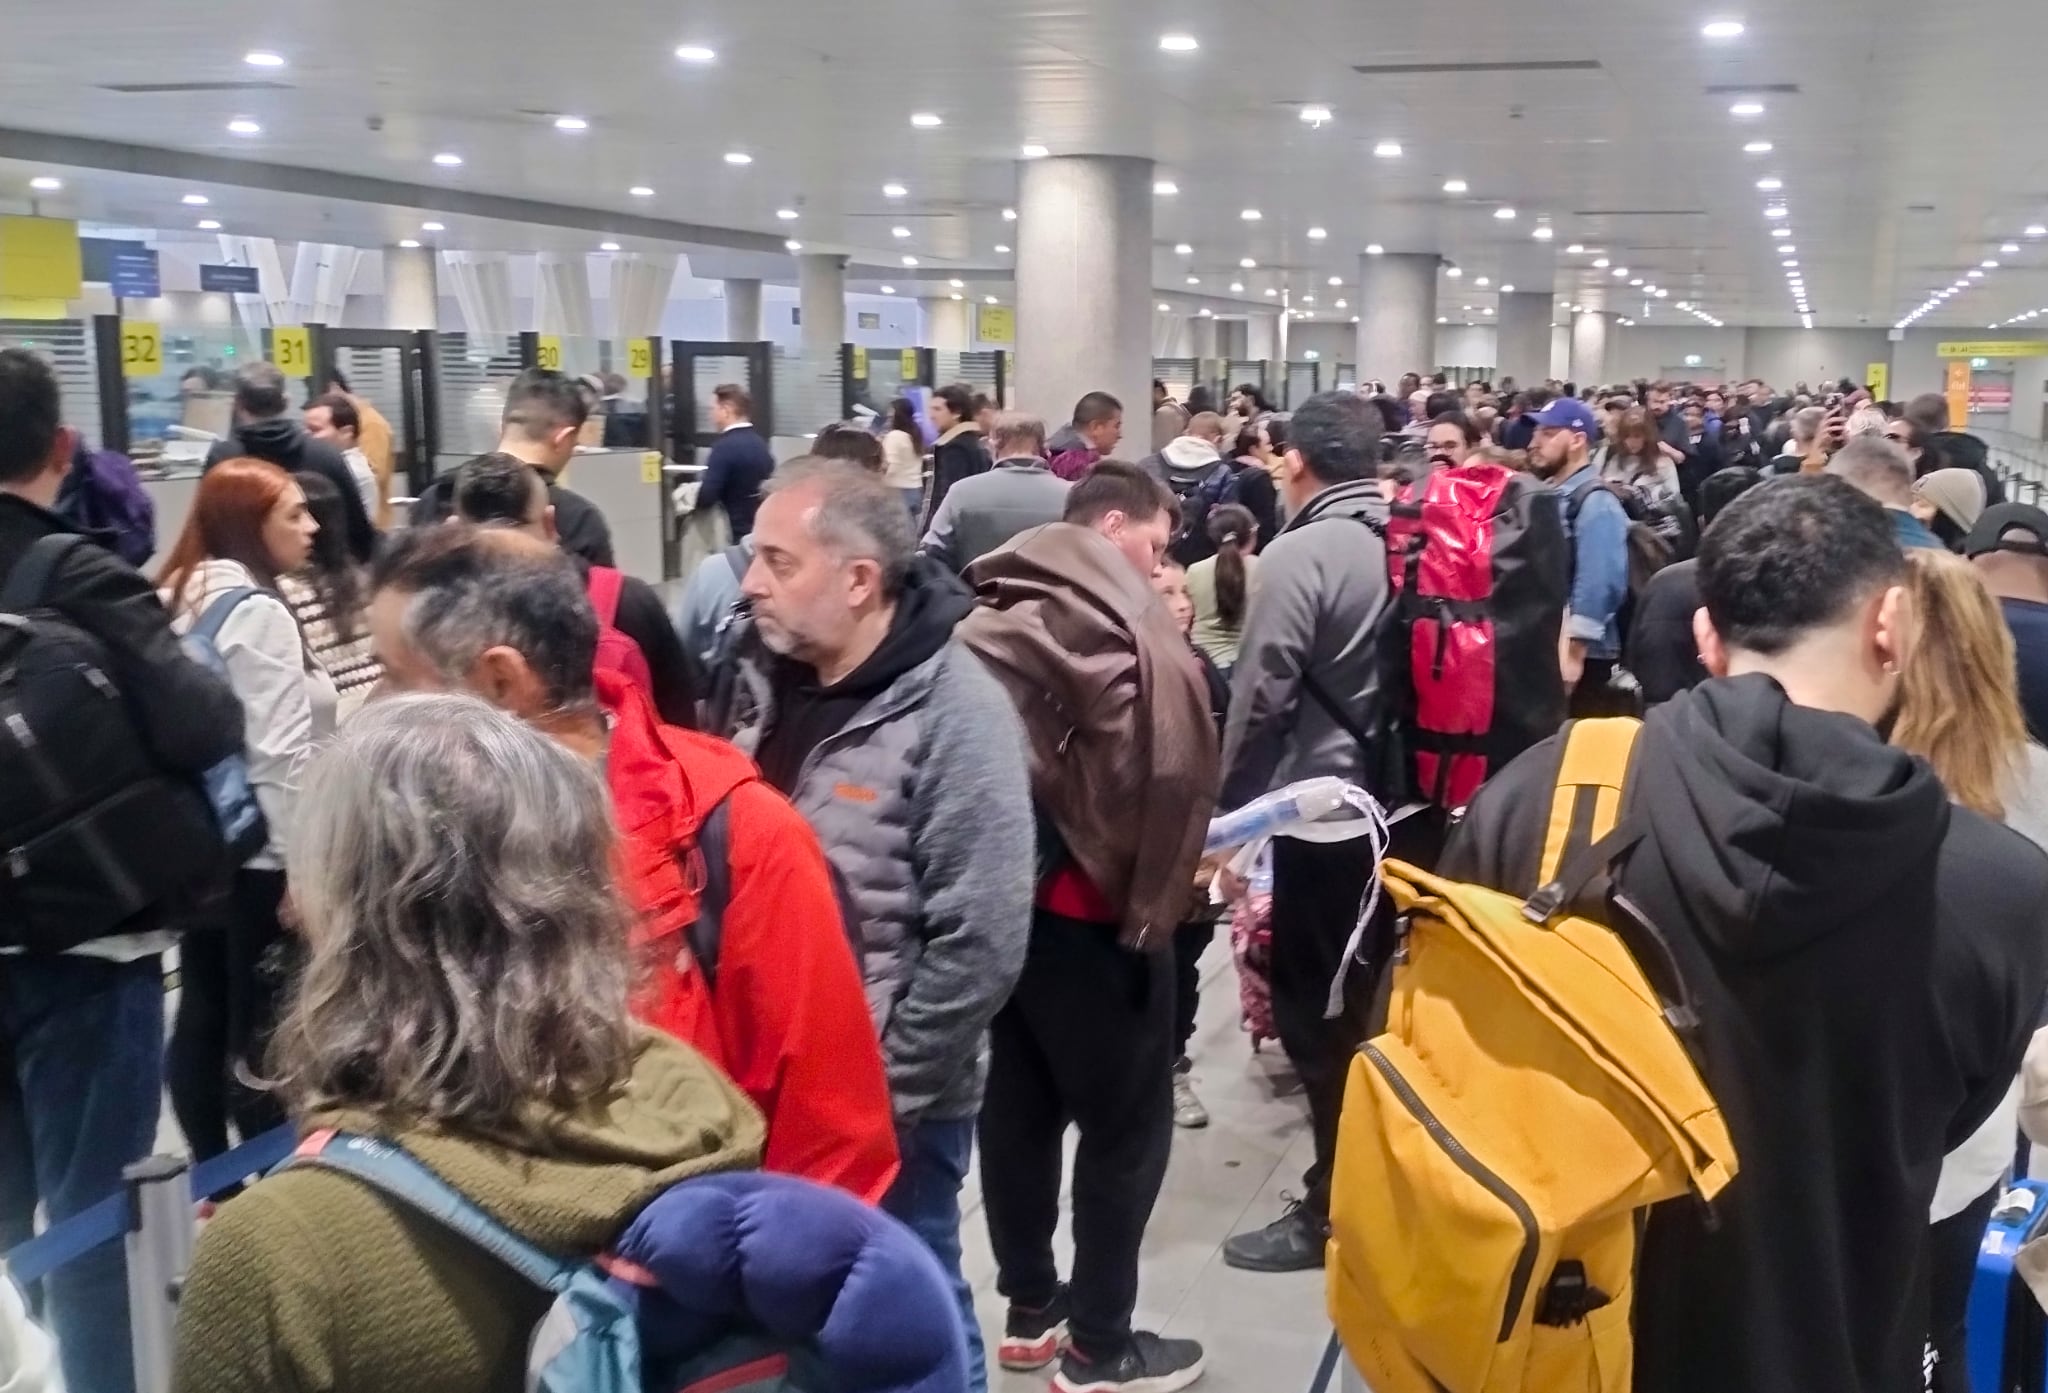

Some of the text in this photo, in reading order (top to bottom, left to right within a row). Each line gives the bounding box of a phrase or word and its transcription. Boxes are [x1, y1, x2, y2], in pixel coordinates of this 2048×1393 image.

[123, 335, 157, 362] 32
[280, 338, 304, 365] 31
[537, 346, 558, 368] 30
[631, 348, 648, 369] 29
